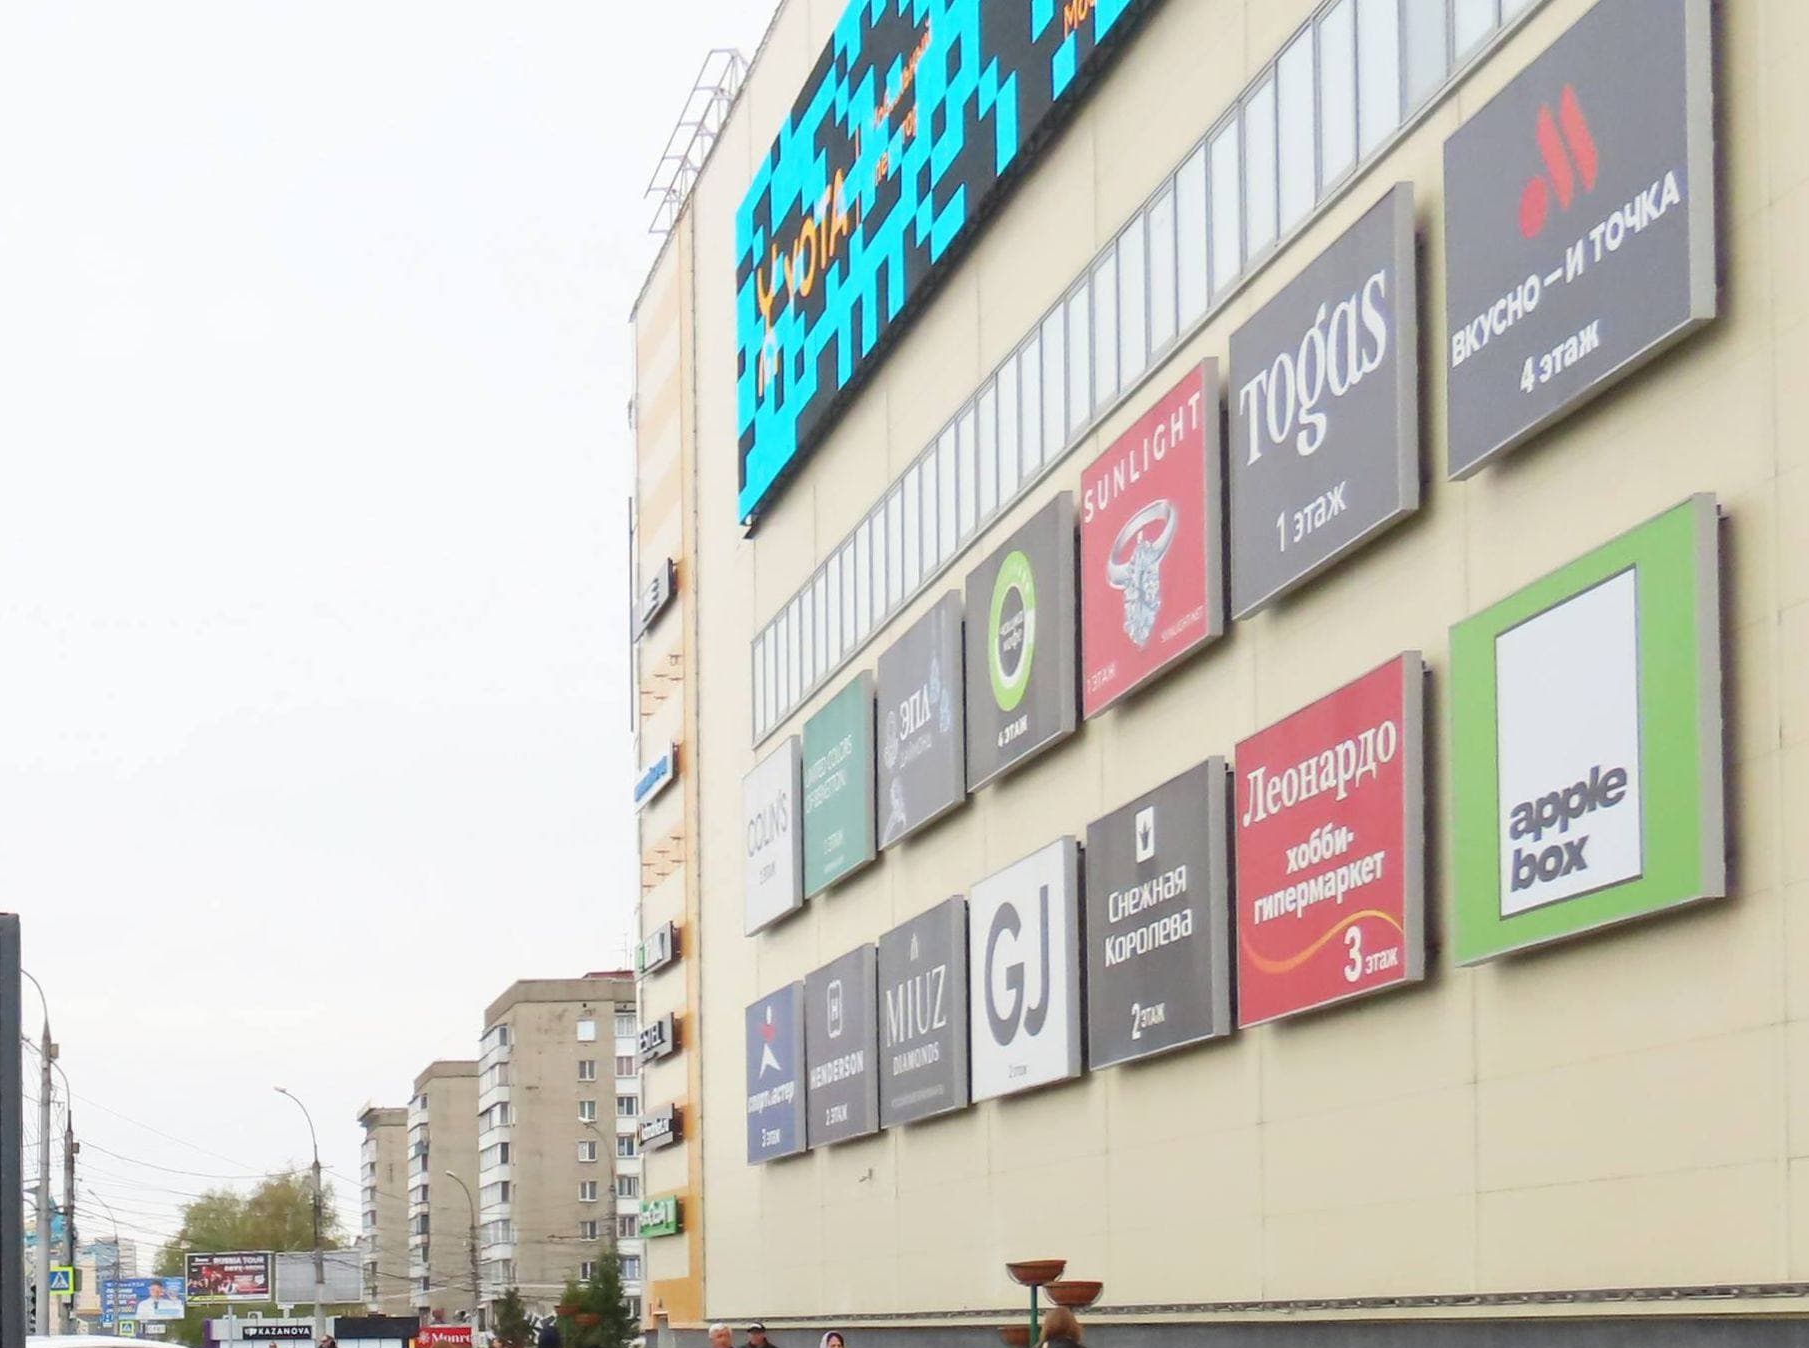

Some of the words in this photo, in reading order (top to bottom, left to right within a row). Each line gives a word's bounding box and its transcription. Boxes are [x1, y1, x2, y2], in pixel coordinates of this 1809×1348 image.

[1451, 274, 1541, 368] ВКУСНО
[1565, 240, 1584, 284] И
[1589, 170, 1681, 262] ТОЧКА
[1519, 355, 1536, 394] 4
[1539, 319, 1600, 383] этаж
[1084, 391, 1202, 524] SUNLIGHT
[1276, 511, 1286, 552] 1
[1293, 480, 1348, 543] этаж
[1243, 720, 1397, 828] Леонардо
[1508, 763, 1629, 842] apple
[1286, 822, 1355, 875] хобби-
[1510, 834, 1590, 894] box
[1108, 865, 1187, 924] Снежная
[1253, 850, 1386, 926] гипермаркет
[984, 884, 1051, 1047] GJ
[1105, 908, 1193, 967] Королева
[1344, 925, 1362, 983] 3
[1365, 947, 1399, 976] этаж
[886, 964, 947, 1048] MIUZ
[1131, 1002, 1142, 1040] 2
[810, 1050, 864, 1090] HENDERSON
[893, 1041, 939, 1076] DIAMONDS
[258, 1327, 311, 1335] KAZANOVA
